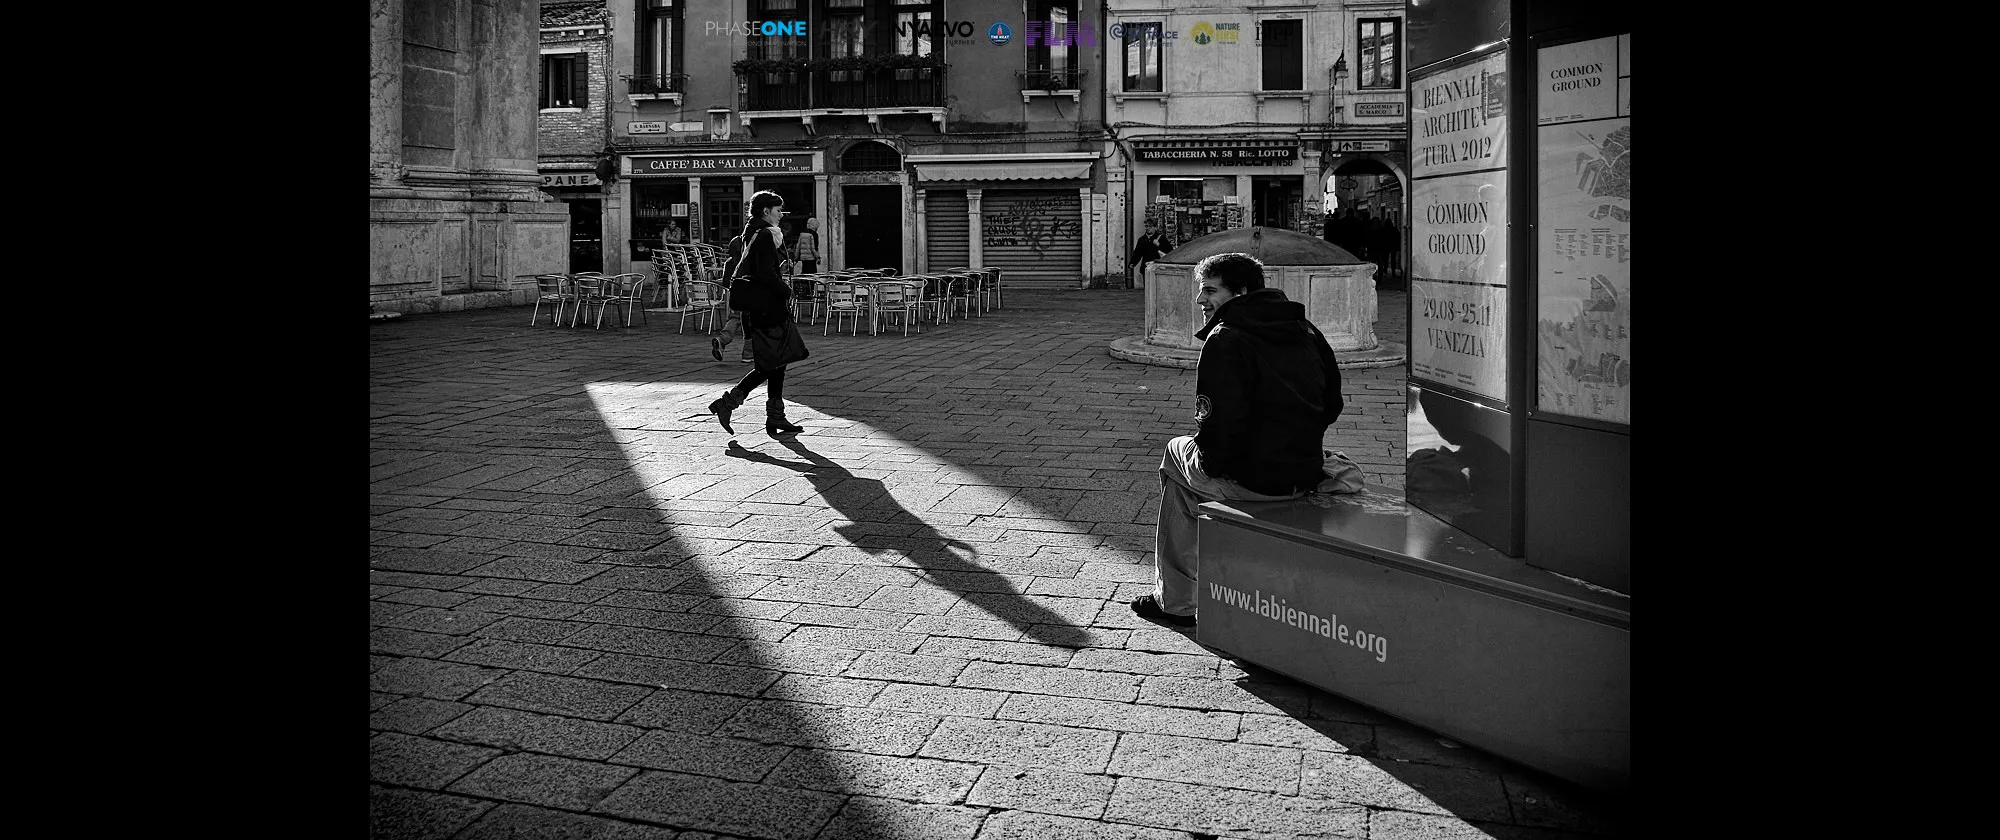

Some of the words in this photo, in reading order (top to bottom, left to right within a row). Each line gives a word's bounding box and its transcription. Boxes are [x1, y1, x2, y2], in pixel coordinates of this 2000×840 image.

[1550, 63, 1603, 80] COMMON
[1424, 75, 1482, 109] BIENNAL
[1552, 77, 1601, 92] GROUND
[1143, 150, 1207, 159] TABACCHERIA
[1210, 150, 1219, 158] N.
[1221, 150, 1233, 158] 58
[1239, 150, 1255, 158] Ric.
[1258, 149, 1289, 158] LOTTO
[1422, 143, 1457, 167] TURA
[1461, 136, 1491, 162] 2012
[650, 160, 690, 170] CAFFE'
[692, 159, 716, 169] BAR
[544, 175, 589, 185] PANE
[1427, 201, 1489, 225] COMMON
[1428, 233, 1486, 255] GROUND
[1423, 298, 1491, 327] 29.08-25.11
[1427, 327, 1485, 358] VENEZIA
[1209, 582, 1388, 663] www.labiennale.org
